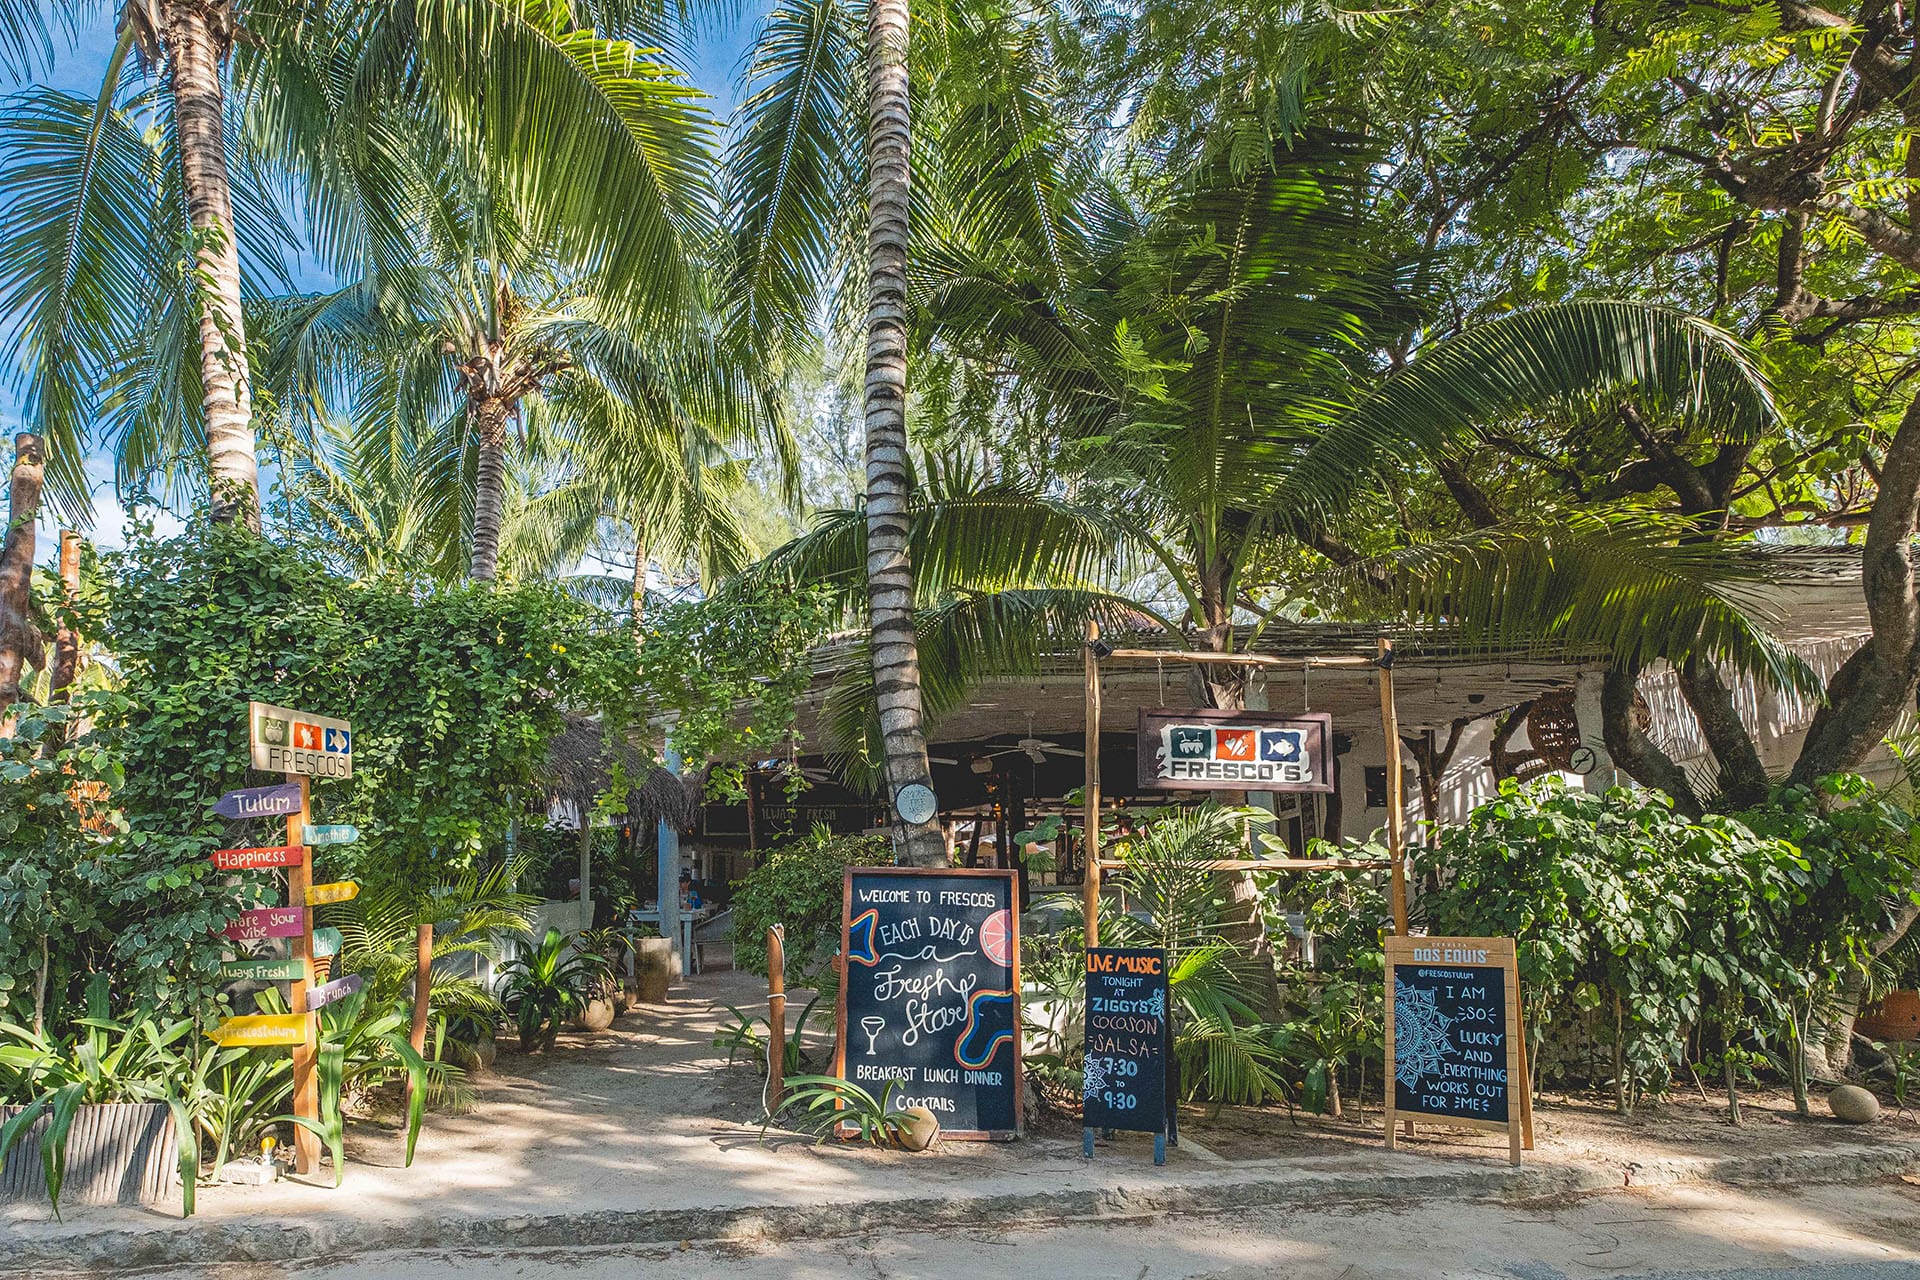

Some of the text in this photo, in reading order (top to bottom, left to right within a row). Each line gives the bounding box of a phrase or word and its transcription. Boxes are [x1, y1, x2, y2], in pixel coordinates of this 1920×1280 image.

[269, 748, 346, 777] FRESCO'S
[1171, 761, 1301, 781] FRESCO'S
[232, 794, 290, 814] Tulum
[217, 850, 286, 867] Happiness
[859, 889, 996, 908] WELCOME TO FRESCO'S
[229, 916, 259, 928] hare
[879, 916, 975, 946] EACH DAY IS
[1087, 953, 1161, 975] LIVE MUSIC
[1413, 948, 1488, 963] DOS EQUIS
[256, 965, 290, 978] Fresh!
[873, 964, 977, 1001] Fresh
[1102, 976, 1143, 988] TONIGHT
[319, 985, 352, 1006] Brunch
[1113, 988, 1126, 997] AT
[1445, 985, 1485, 1000] I AM
[1092, 997, 1149, 1014] ZIGGY'S
[1466, 1006, 1487, 1020] SO
[1460, 1030, 1503, 1046] LUCKY
[1464, 1049, 1493, 1063] AND
[857, 1064, 1002, 1086] BREAKFAST LUNCH DINNER
[1104, 1057, 1138, 1077] 7:30
[1444, 1063, 1507, 1082] EVERYTHING
[1115, 1080, 1125, 1088] TO
[1426, 1080, 1504, 1098] WORKS OUT
[896, 1095, 956, 1113] COCKTAILS
[1104, 1091, 1137, 1109] 9:30
[1422, 1095, 1480, 1111] FOR ME
